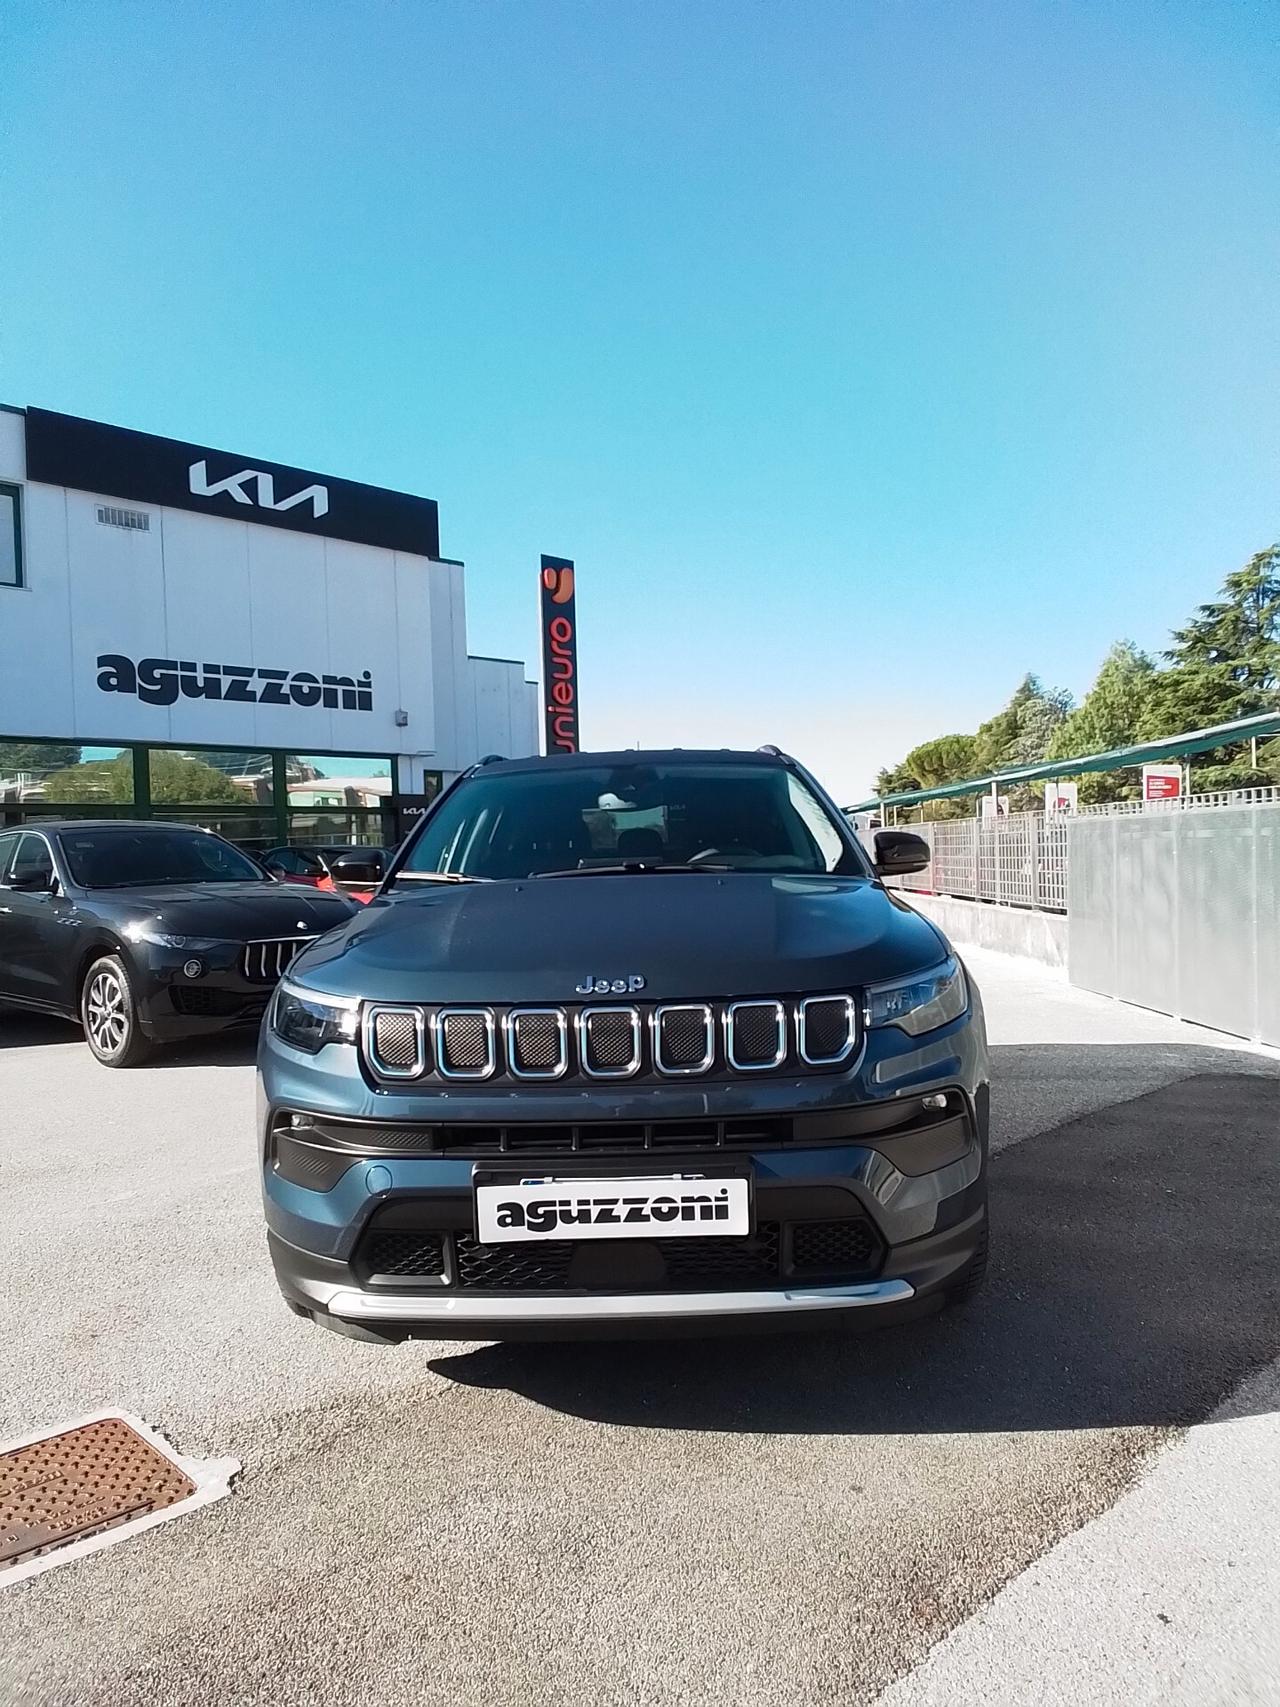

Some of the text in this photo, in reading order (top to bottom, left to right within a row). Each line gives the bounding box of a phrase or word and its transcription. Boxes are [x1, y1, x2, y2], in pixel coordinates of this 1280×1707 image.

[189, 460, 328, 518] KIA
[96, 654, 374, 712] aguzzoni
[575, 975, 645, 994] Jeep
[496, 1188, 729, 1233] aguzzoni
